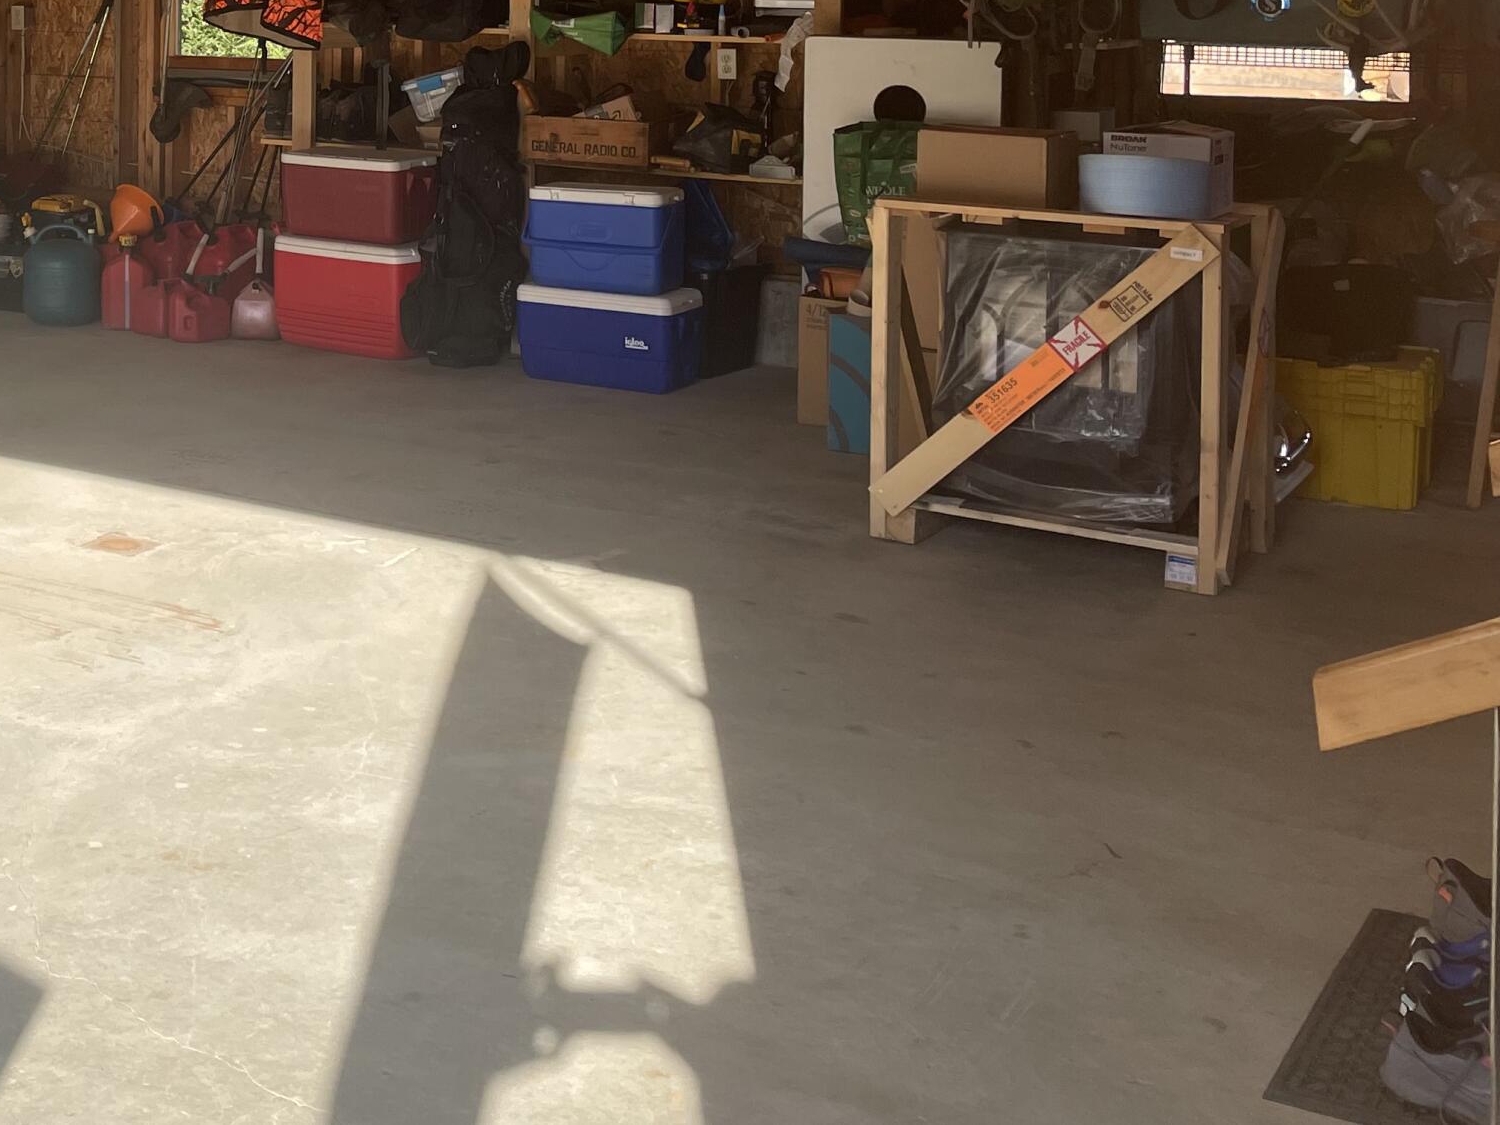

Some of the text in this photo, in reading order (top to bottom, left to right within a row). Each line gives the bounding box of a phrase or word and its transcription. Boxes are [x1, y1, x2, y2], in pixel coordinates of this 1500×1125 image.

[531, 139, 581, 156] GENERAL
[584, 142, 618, 158] RADIO
[1062, 331, 1092, 356] FRAGILE
